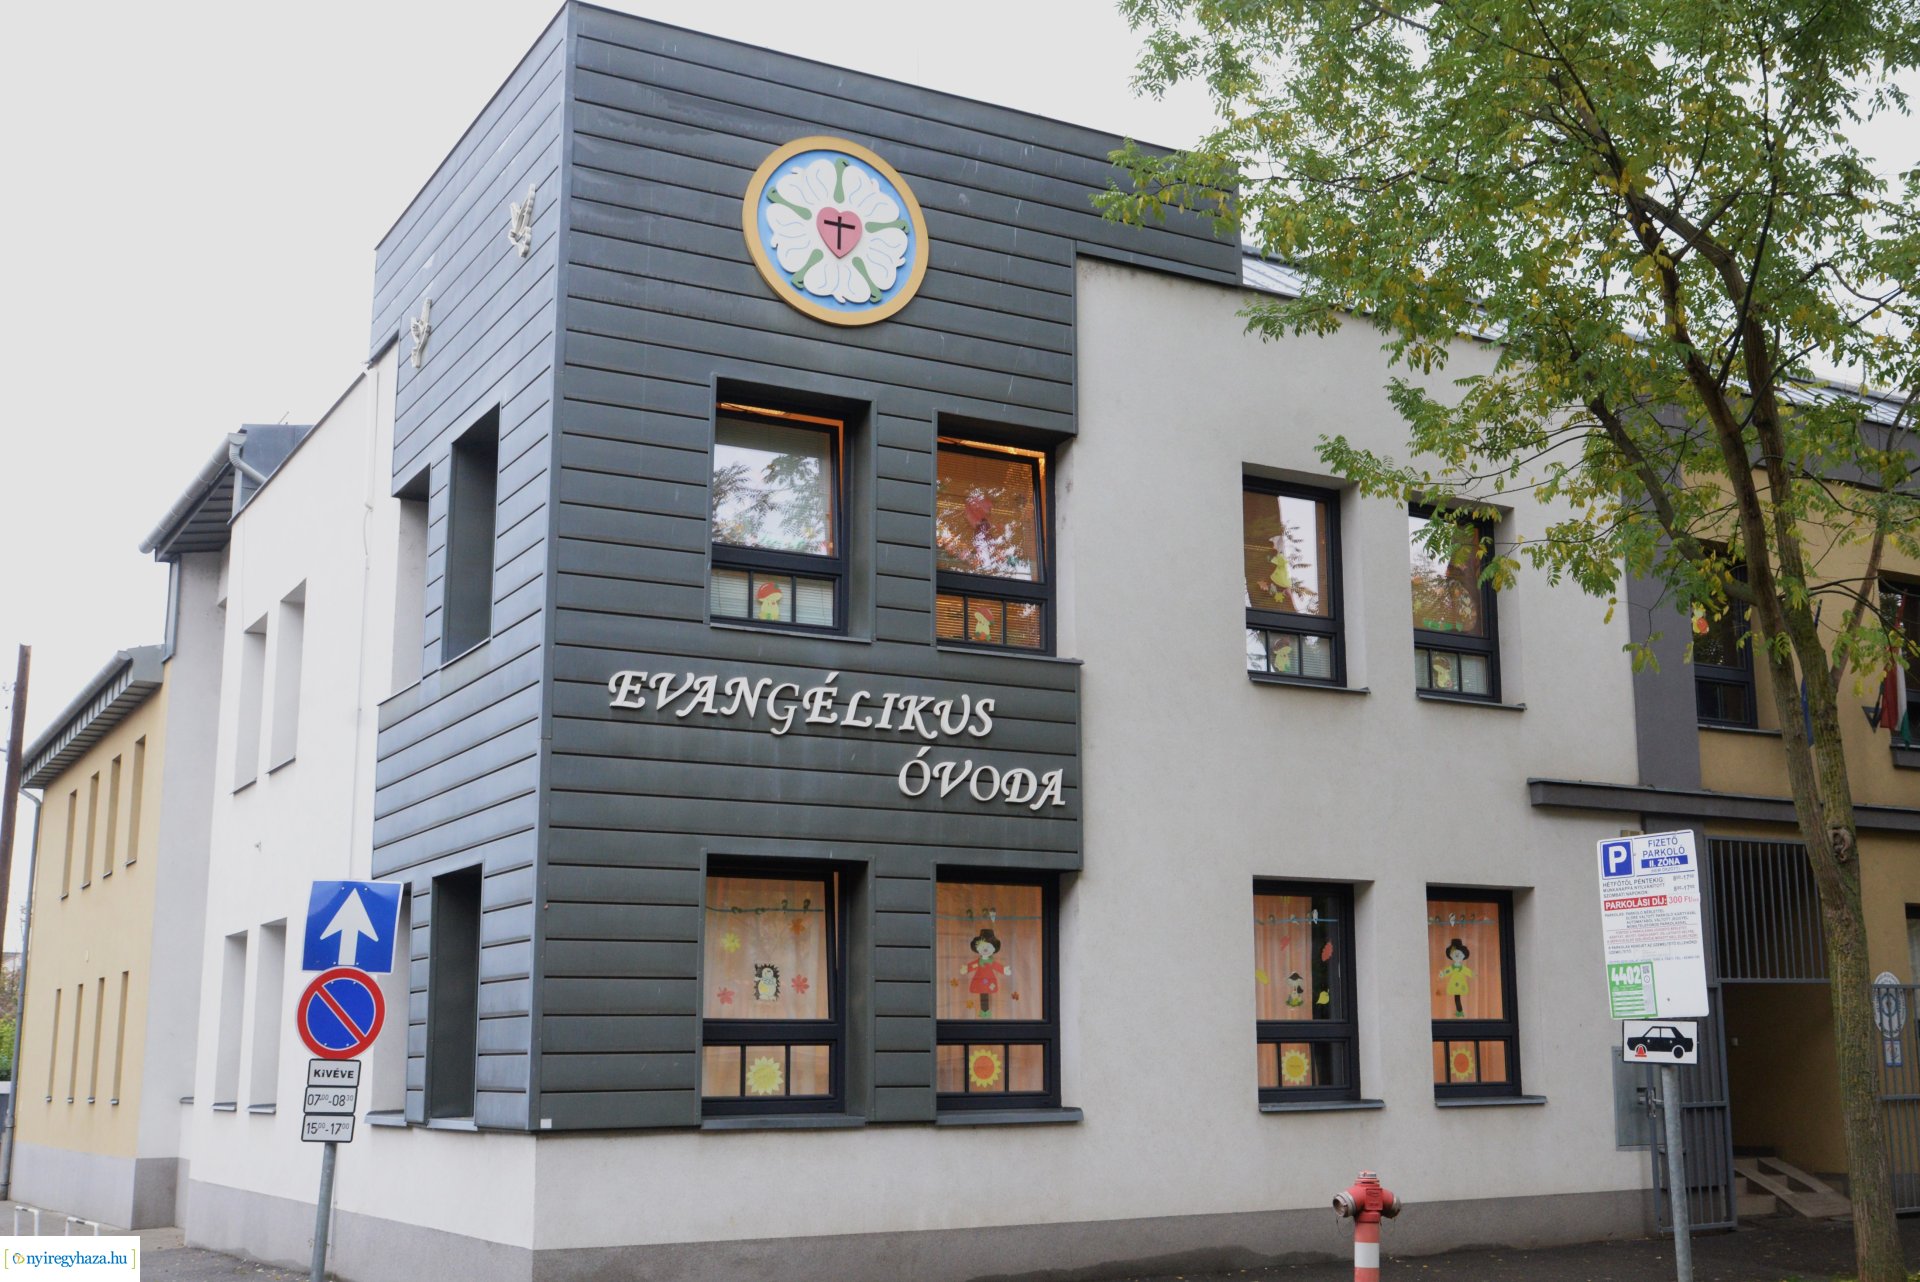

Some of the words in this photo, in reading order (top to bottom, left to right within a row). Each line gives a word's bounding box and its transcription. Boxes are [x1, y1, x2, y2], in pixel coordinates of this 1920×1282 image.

[607, 671, 995, 740] EVANGÉLIKUS
[898, 746, 1066, 811] ÓVODA
[1647, 836, 1678, 848] FIZETŐ
[1608, 845, 1628, 873] P
[1642, 844, 1686, 859] PARKOLÓ
[1657, 857, 1681, 867] ZÓNA
[1605, 897, 1651, 910] PARKOLÁSI
[1651, 895, 1667, 905] DÍJ:
[1668, 895, 1683, 904] 300
[1612, 965, 1642, 986] 4402
